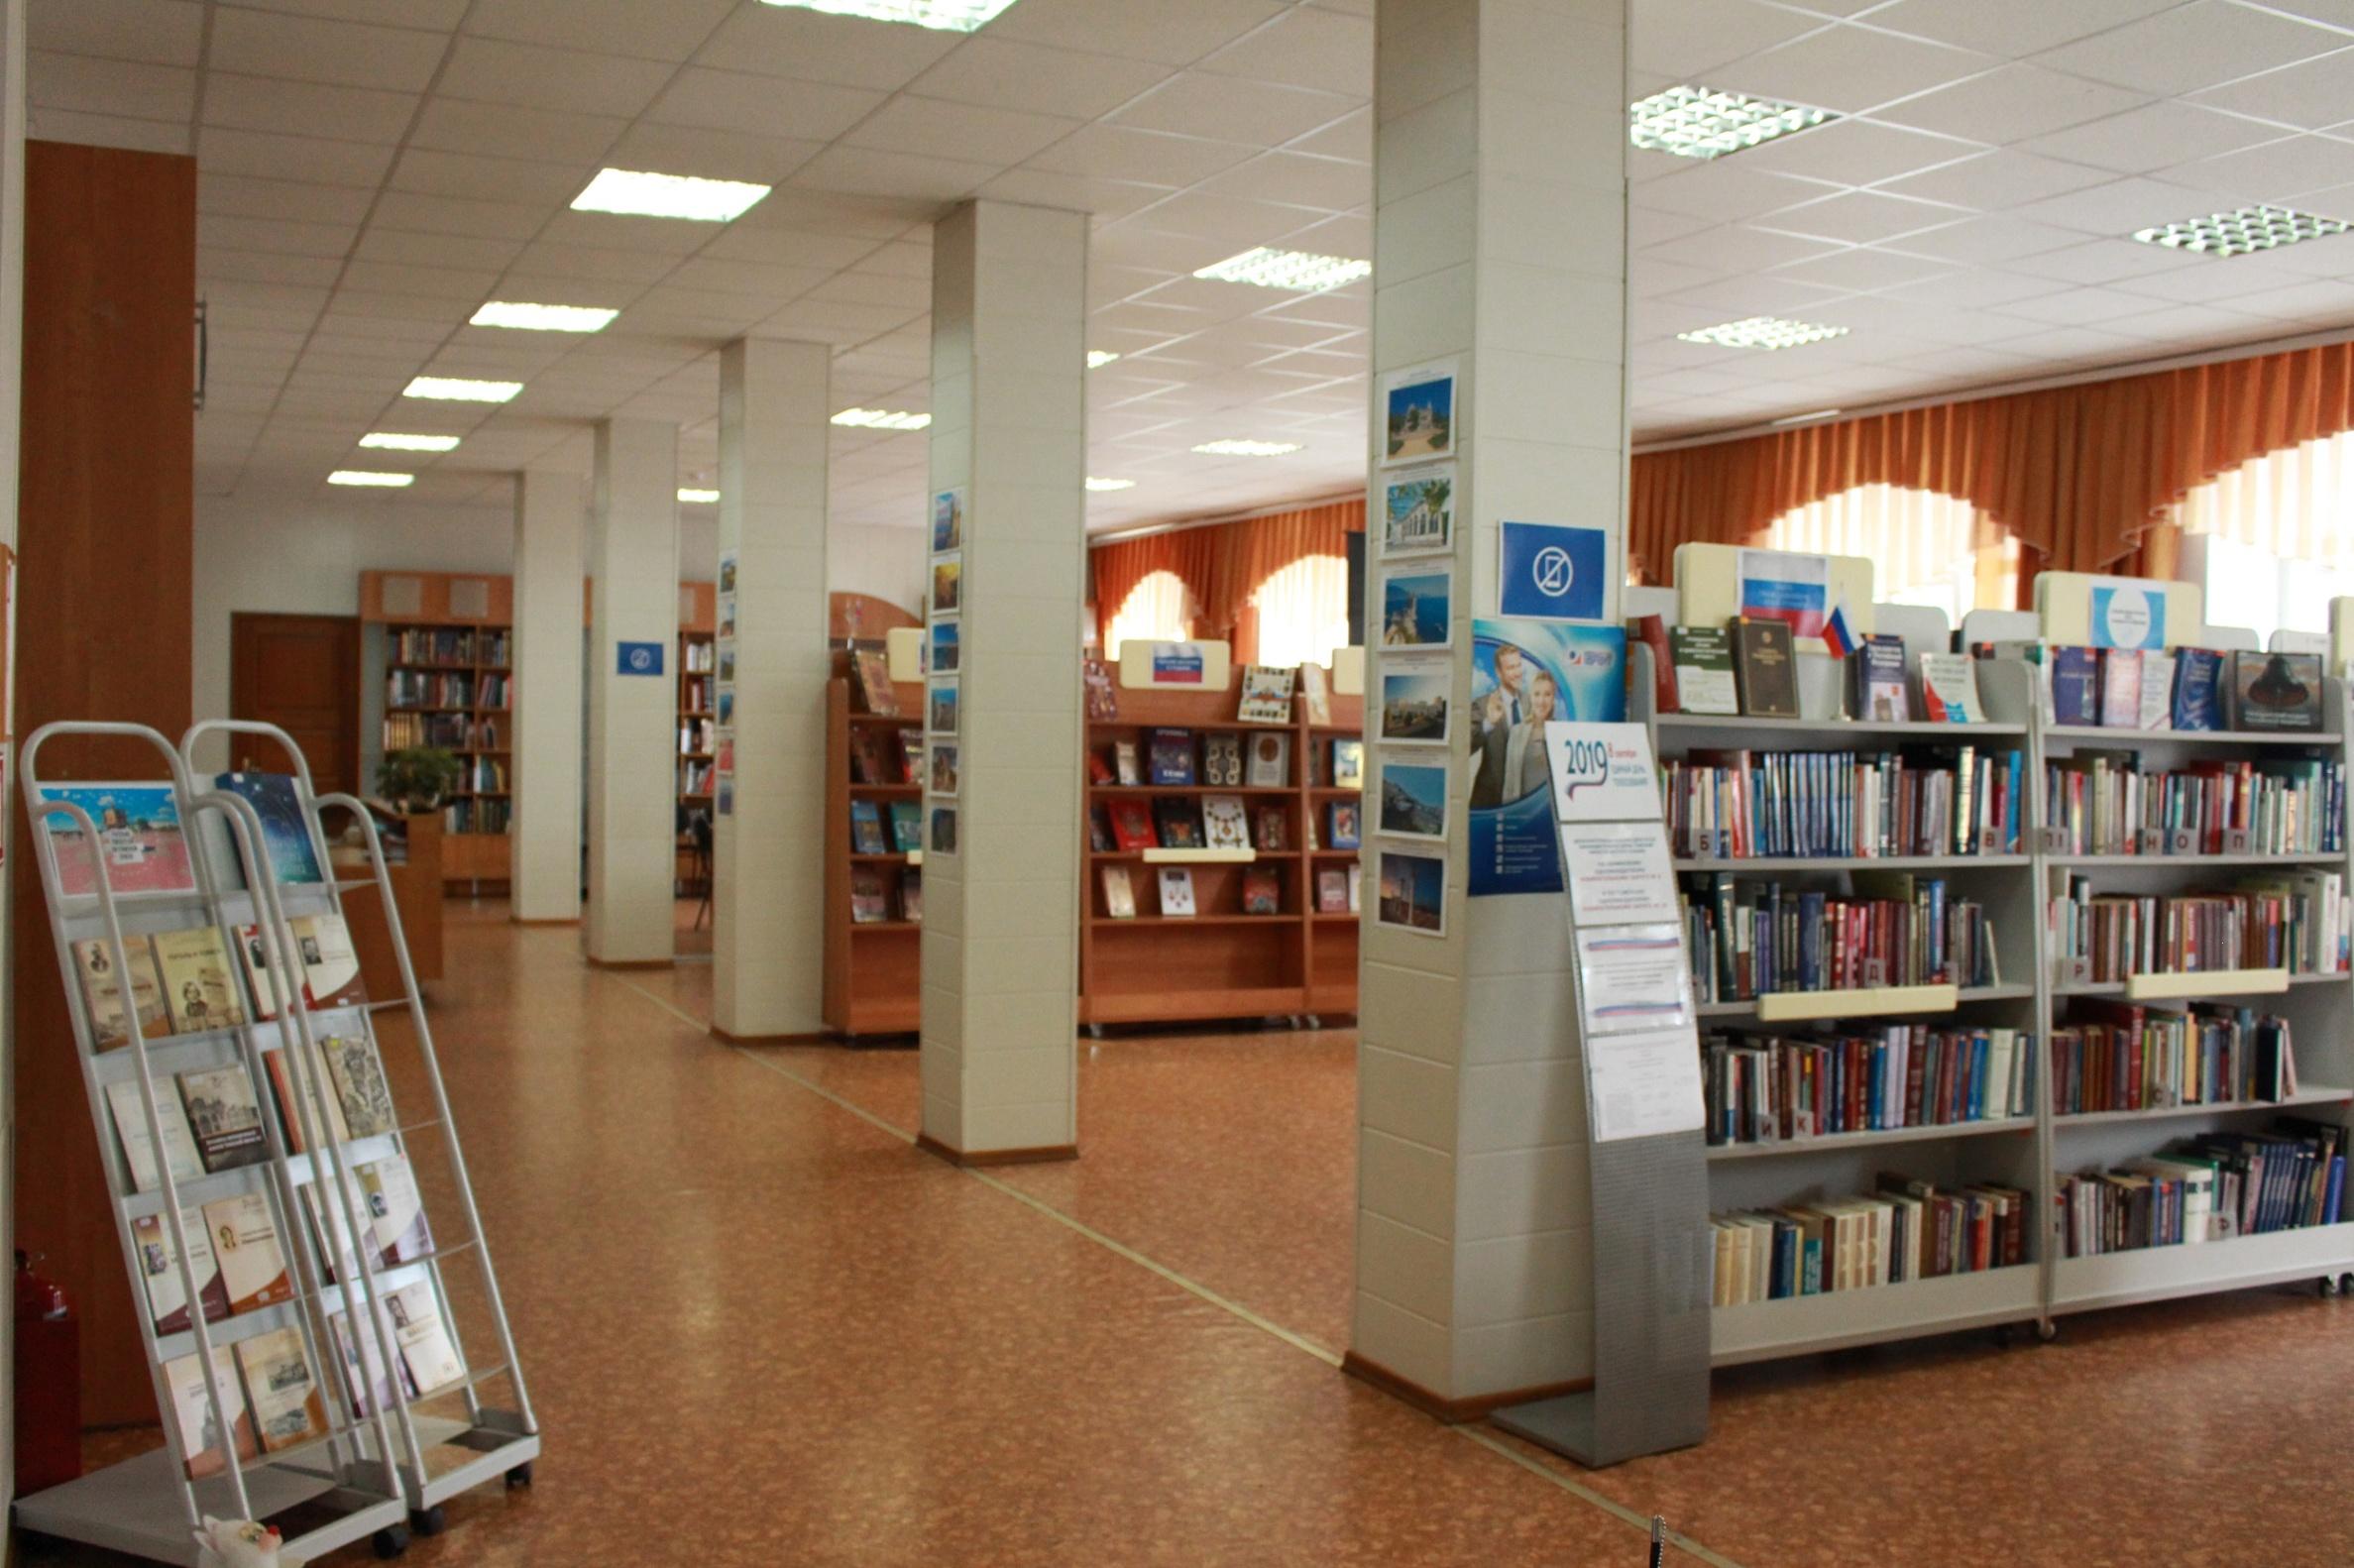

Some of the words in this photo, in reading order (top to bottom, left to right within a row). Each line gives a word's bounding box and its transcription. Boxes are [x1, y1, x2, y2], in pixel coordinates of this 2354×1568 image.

[1564, 738, 1608, 785] 2019
[1699, 834, 1710, 850] Б
[1985, 832, 1995, 847] В
[2176, 834, 2188, 849] О
[2233, 834, 2244, 848] П
[1797, 1115, 1807, 1133] К
